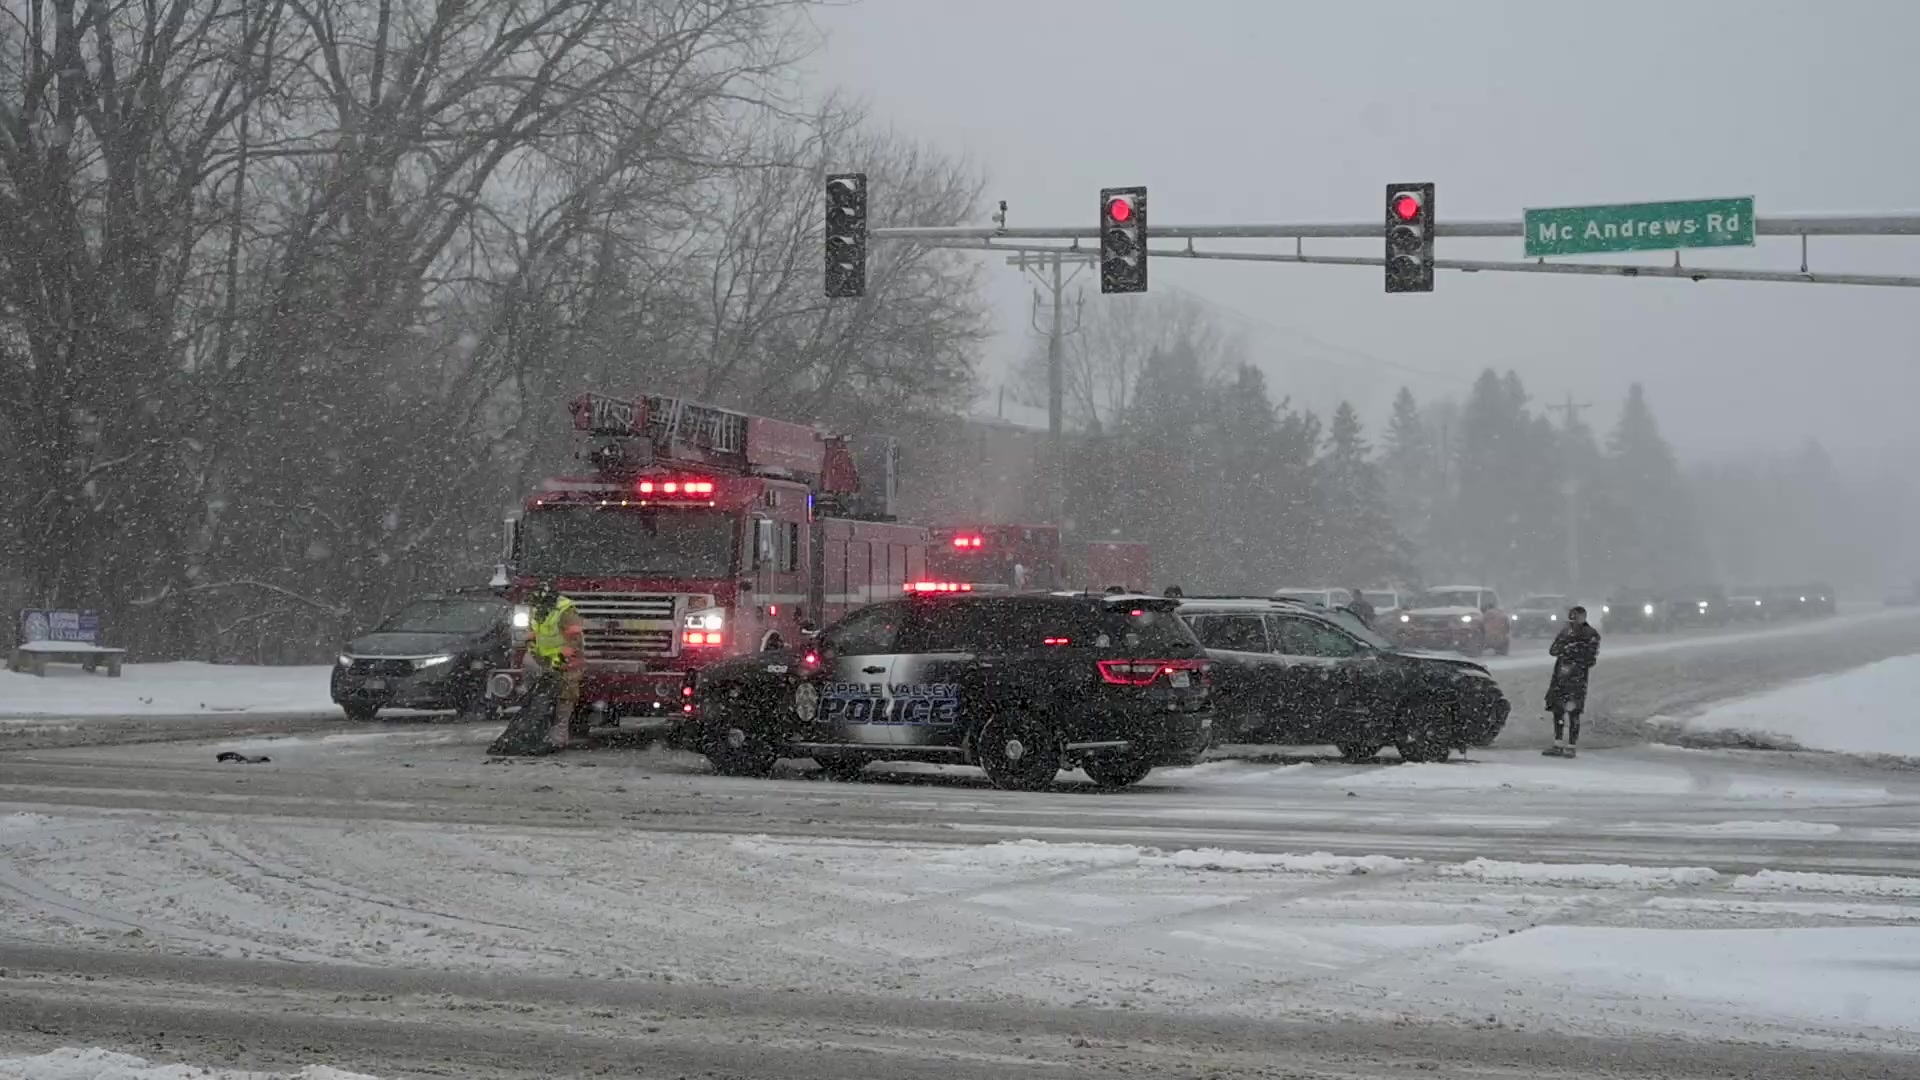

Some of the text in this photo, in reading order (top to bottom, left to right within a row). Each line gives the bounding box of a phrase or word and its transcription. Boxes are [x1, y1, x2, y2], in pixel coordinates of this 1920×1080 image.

[1539, 213, 1739, 242] Mc Andrews Rd
[822, 683, 959, 697] APPLE VALLEY
[817, 697, 960, 726] POLICE
